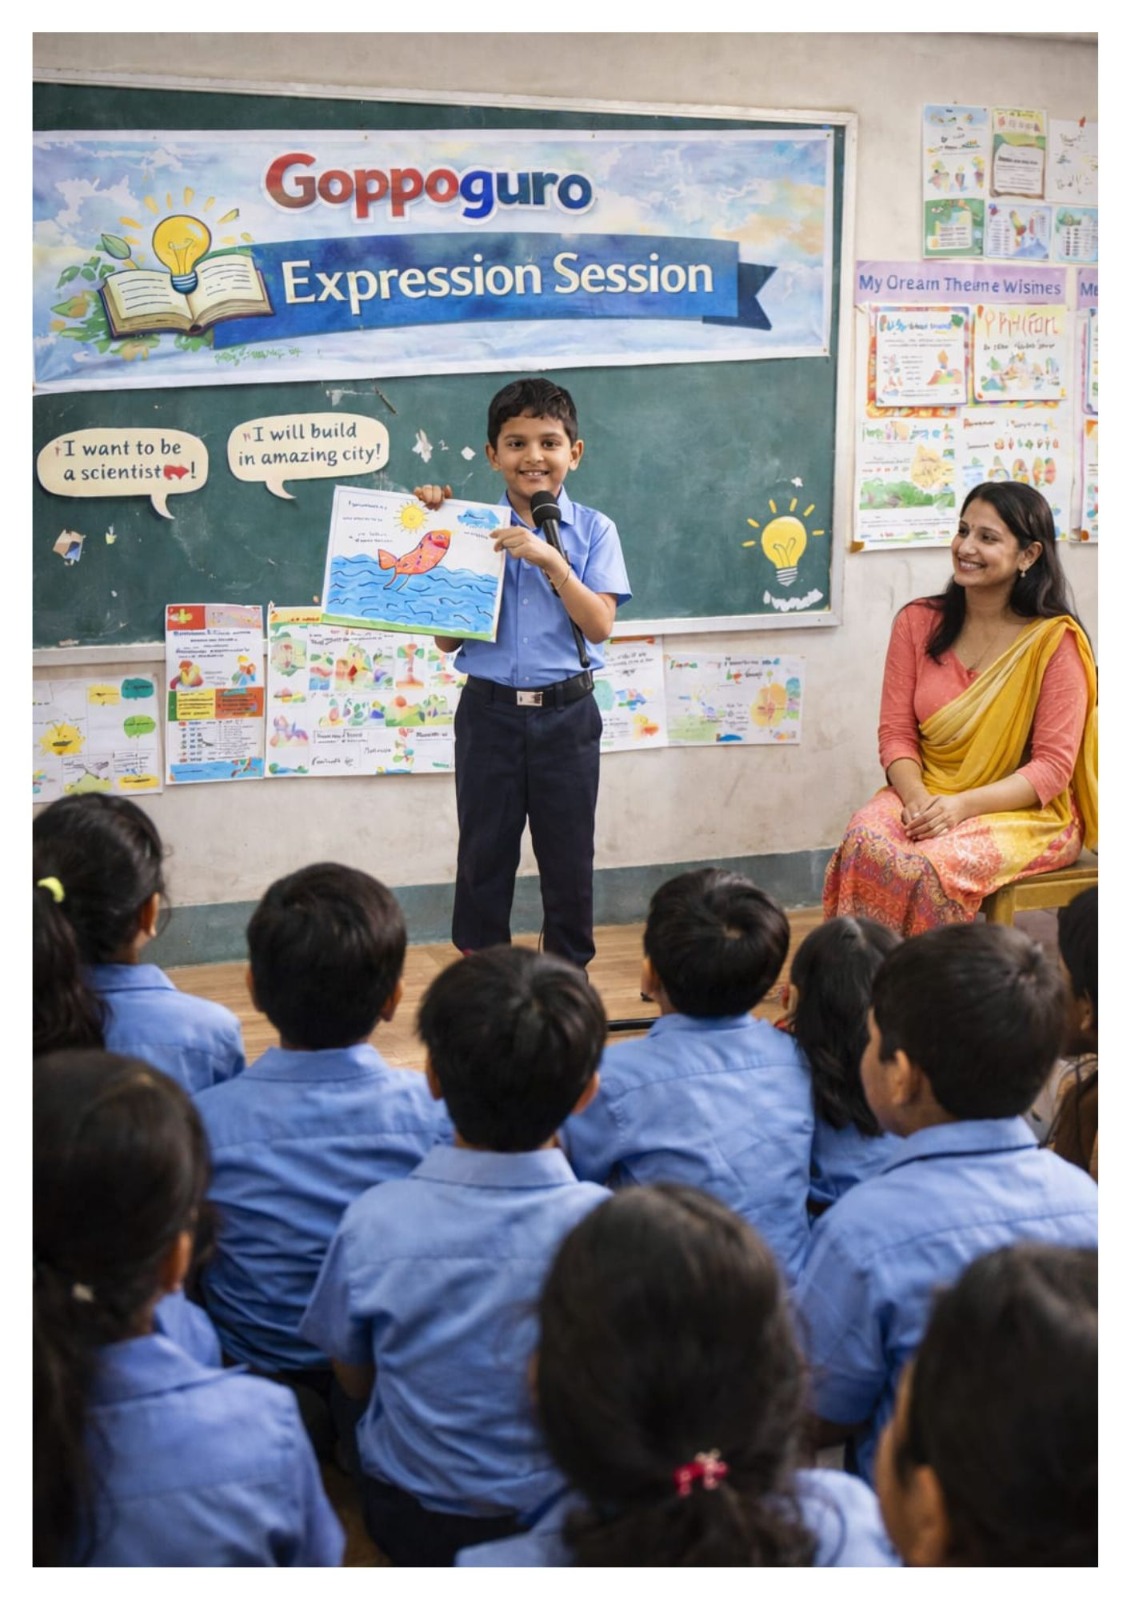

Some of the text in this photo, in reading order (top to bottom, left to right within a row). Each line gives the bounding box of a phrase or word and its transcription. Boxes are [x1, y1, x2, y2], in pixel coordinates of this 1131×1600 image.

[265, 152, 593, 219] Goppoguro
[282, 252, 714, 316] Expression Session
[859, 274, 882, 294] My
[253, 421, 357, 442] I will build
[63, 438, 181, 456] I want to be
[238, 443, 382, 467] in amazing city!
[64, 468, 76, 481] a
